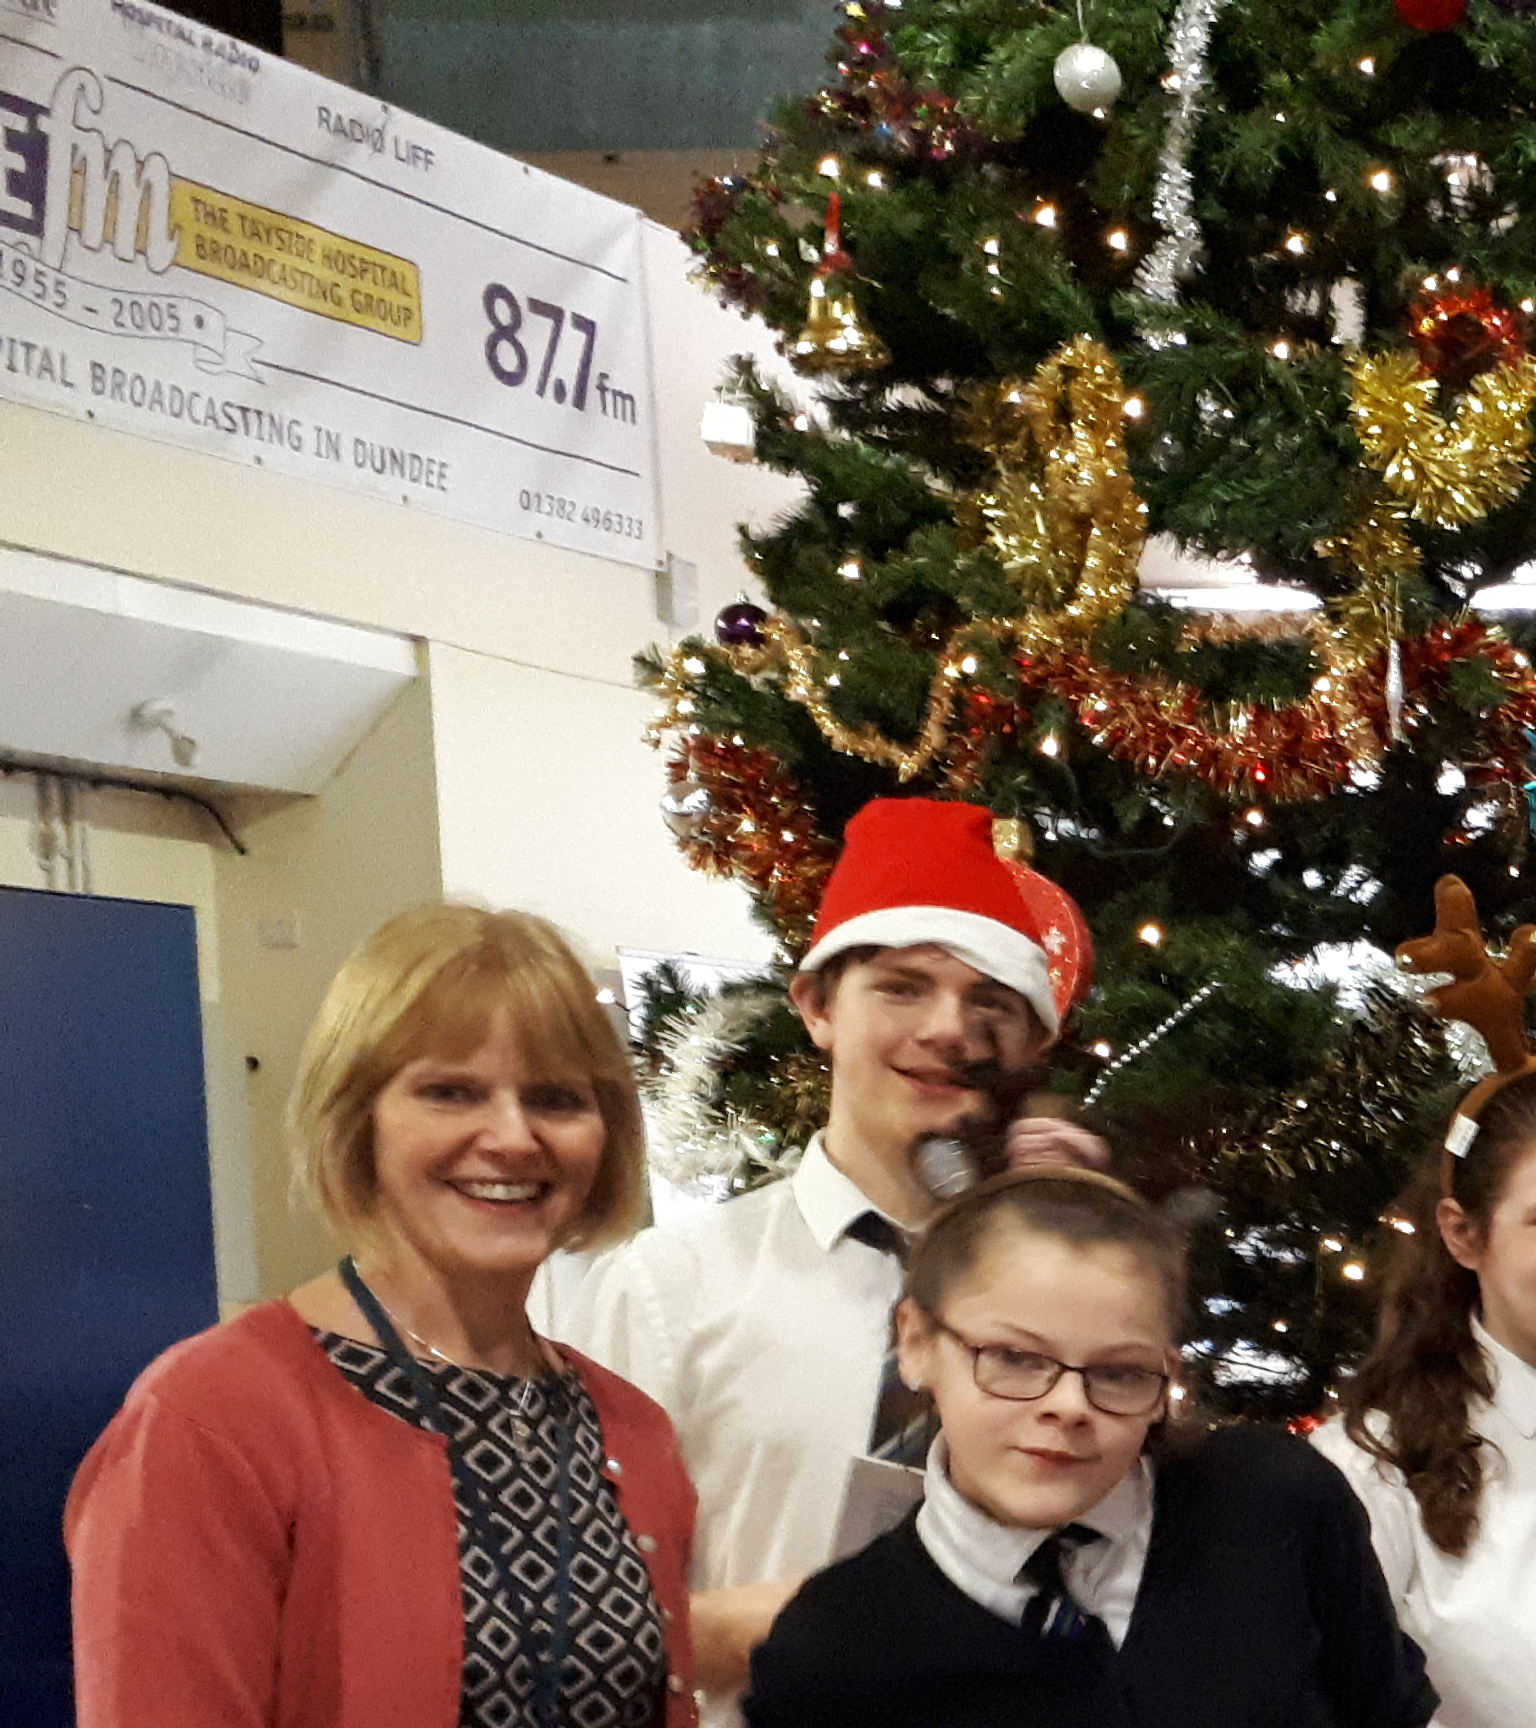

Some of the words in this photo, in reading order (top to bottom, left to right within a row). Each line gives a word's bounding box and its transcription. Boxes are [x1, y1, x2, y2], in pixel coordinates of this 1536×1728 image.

[317, 106, 386, 154] RADIO
[394, 135, 435, 172] LIFF
[191, 196, 231, 234] THE
[237, 213, 315, 264] TAYSIDE
[322, 248, 413, 297] HOSPITAL
[195, 234, 342, 307] BROADCASTING
[351, 288, 412, 328] GROUP
[111, 297, 181, 332] 2005
[483, 283, 596, 412] 87.7
[596, 372, 637, 426] fm
[0, 336, 75, 389] ITAL
[90, 360, 303, 453] BROADCASTING
[314, 425, 342, 462] IN
[353, 438, 449, 493] DUNDEE
[520, 489, 577, 523] 01382
